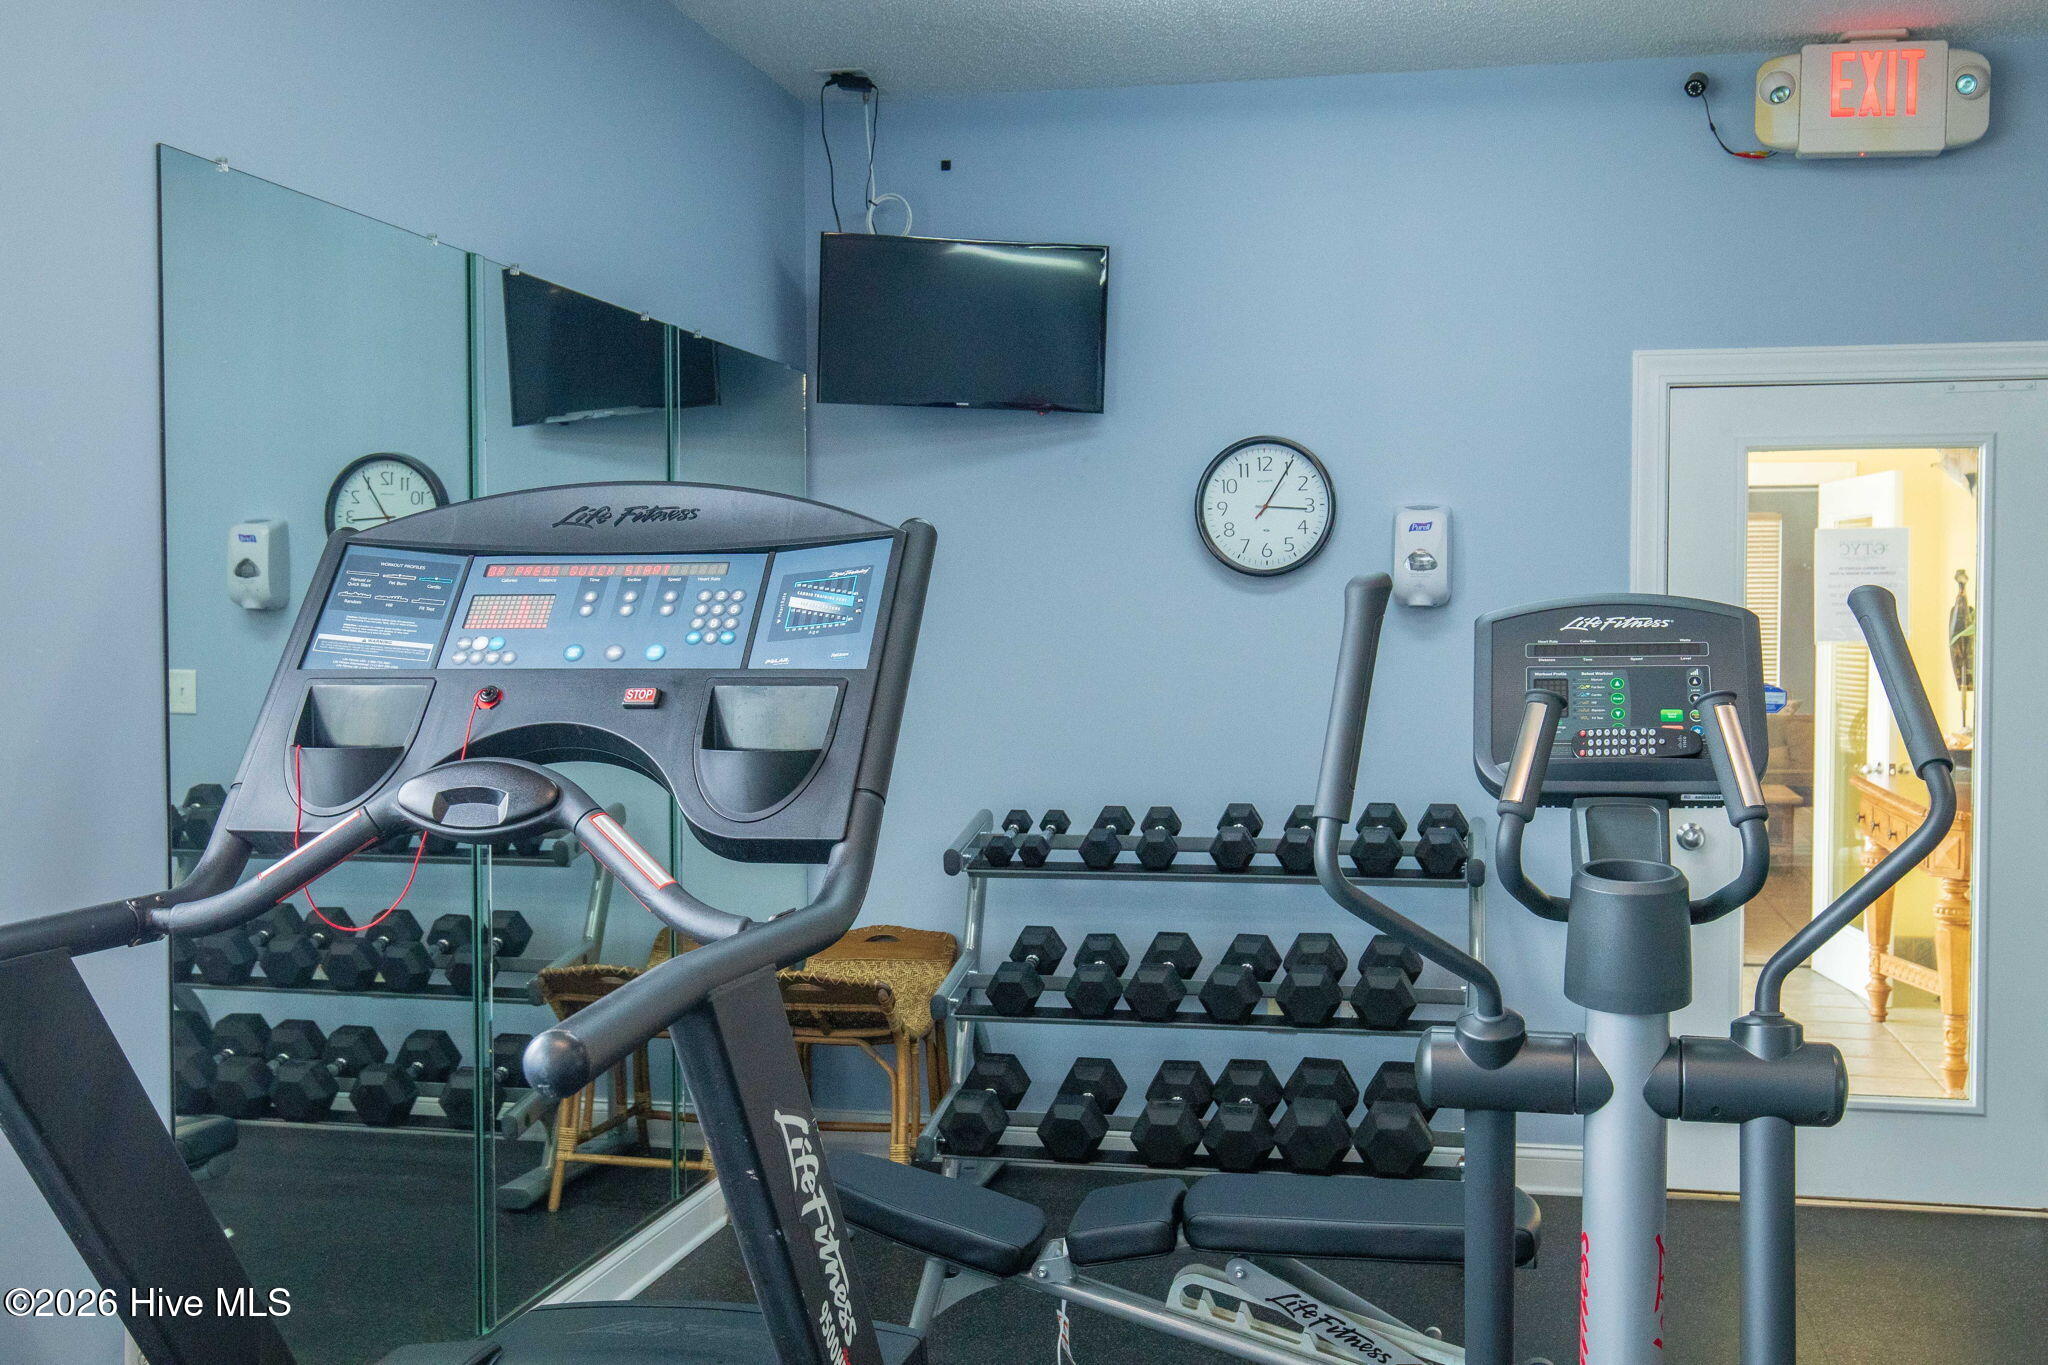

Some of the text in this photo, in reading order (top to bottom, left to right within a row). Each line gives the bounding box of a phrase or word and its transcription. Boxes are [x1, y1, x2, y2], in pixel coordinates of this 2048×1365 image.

[1830, 49, 1926, 118] EXIT
[1238, 463, 1250, 478] 11
[1257, 456, 1273, 472] 12
[1222, 479, 1238, 494] 10
[1297, 476, 1309, 491] 2
[1217, 501, 1228, 516] 9
[1304, 498, 1315, 514] 3
[552, 505, 701, 529] Life Fitness
[1223, 522, 1235, 537] 8
[1297, 520, 1309, 535] 4
[1240, 539, 1250, 554] 7
[1261, 542, 1273, 558] 6
[1284, 537, 1295, 552] 5
[404, 563, 426, 571] PROFILES
[514, 565, 560, 577] PRESS
[624, 564, 670, 576] START
[1560, 616, 1671, 632] Life Fitness
[626, 689, 653, 700] STOP
[774, 1109, 857, 1347] Life Fitness
[1265, 1293, 1392, 1364] Life Fitness
